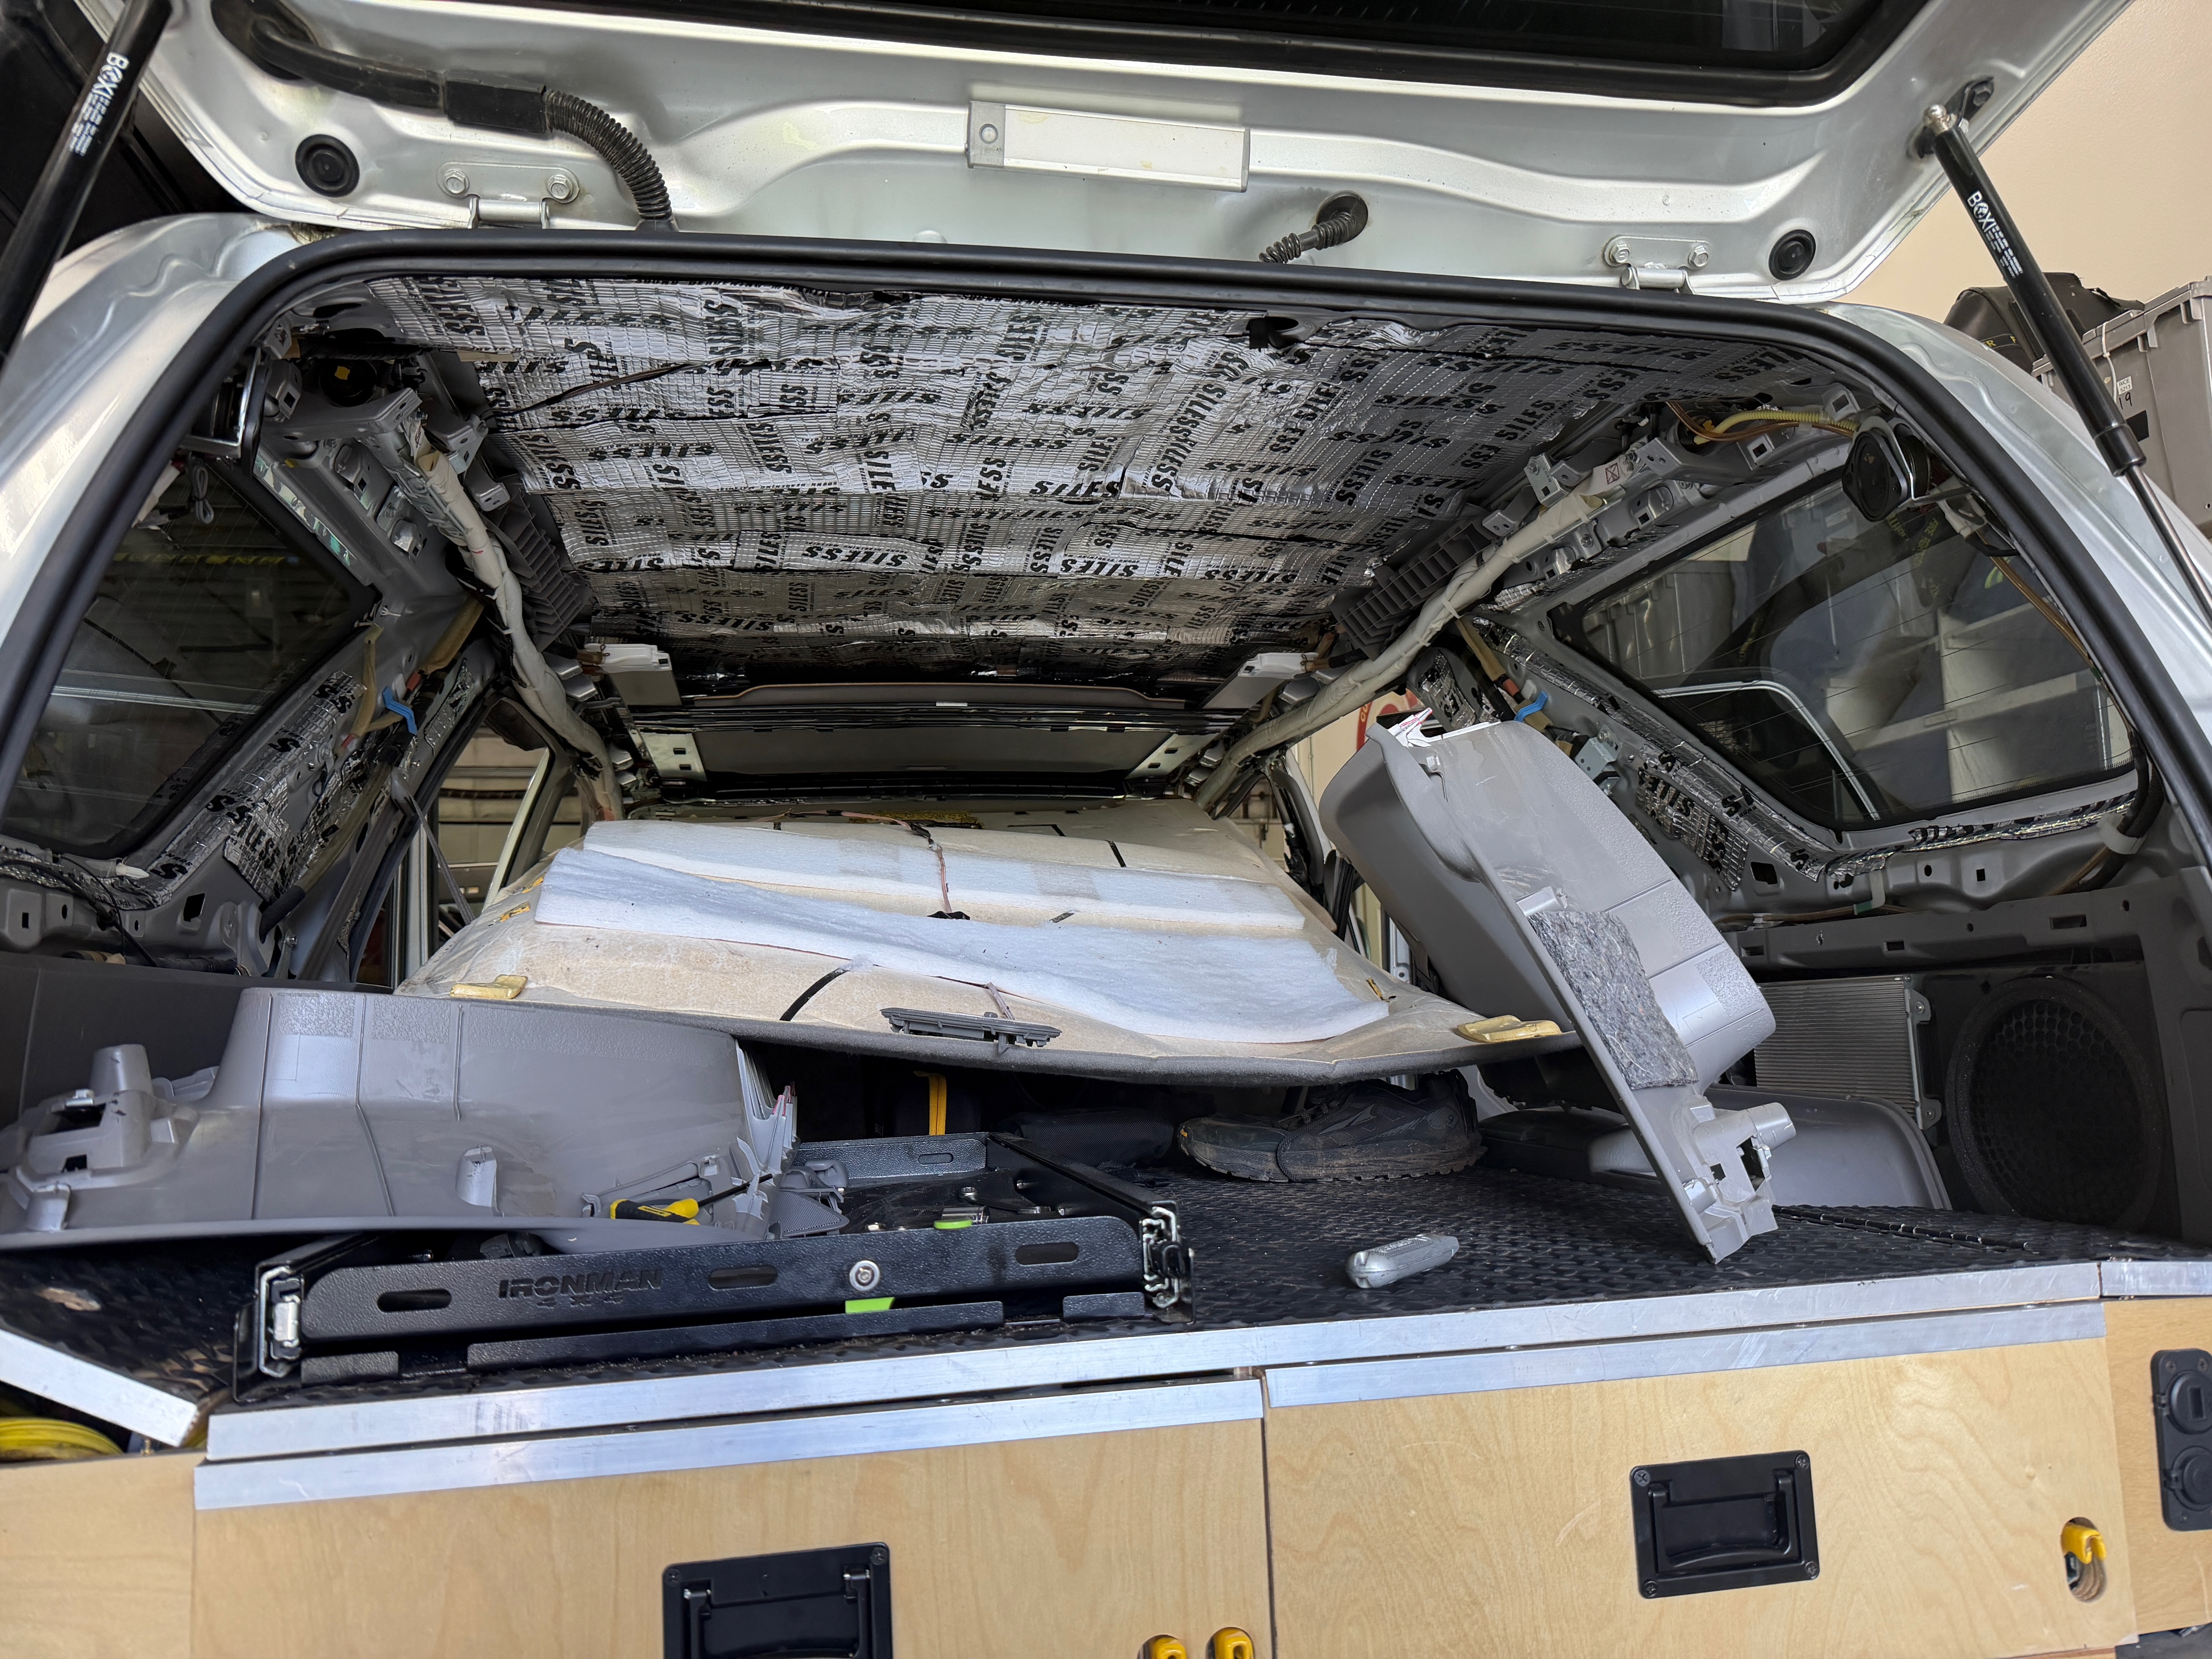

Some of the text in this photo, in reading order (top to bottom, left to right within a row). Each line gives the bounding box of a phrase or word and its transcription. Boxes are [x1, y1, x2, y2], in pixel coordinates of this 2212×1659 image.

[2119, 378, 2130, 386] RICE
[1169, 384, 1227, 437] SILESS
[2119, 392, 2132, 409] 19
[1494, 399, 1556, 440] SILES
[587, 444, 716, 460] SILESS
[745, 423, 793, 474] SILESS
[946, 433, 1073, 450] SILESS
[1460, 443, 1502, 470] ESS
[519, 434, 581, 489] SILESS
[864, 450, 896, 491] SILE
[1151, 436, 1197, 491] SILESS
[1029, 480, 1121, 498] SILES
[1334, 449, 1393, 506] SILESS
[801, 546, 908, 567] SILESS
[1030, 527, 1064, 574] SILESS
[1164, 542, 1194, 577] SILE
[1061, 558, 1139, 577] SILES
[1204, 569, 1298, 583] SILESS
[1321, 555, 1355, 585] SILE
[788, 581, 808, 612] SILESS
[679, 613, 774, 631] SILESS
[499, 1269, 663, 1299] IRONMAN
